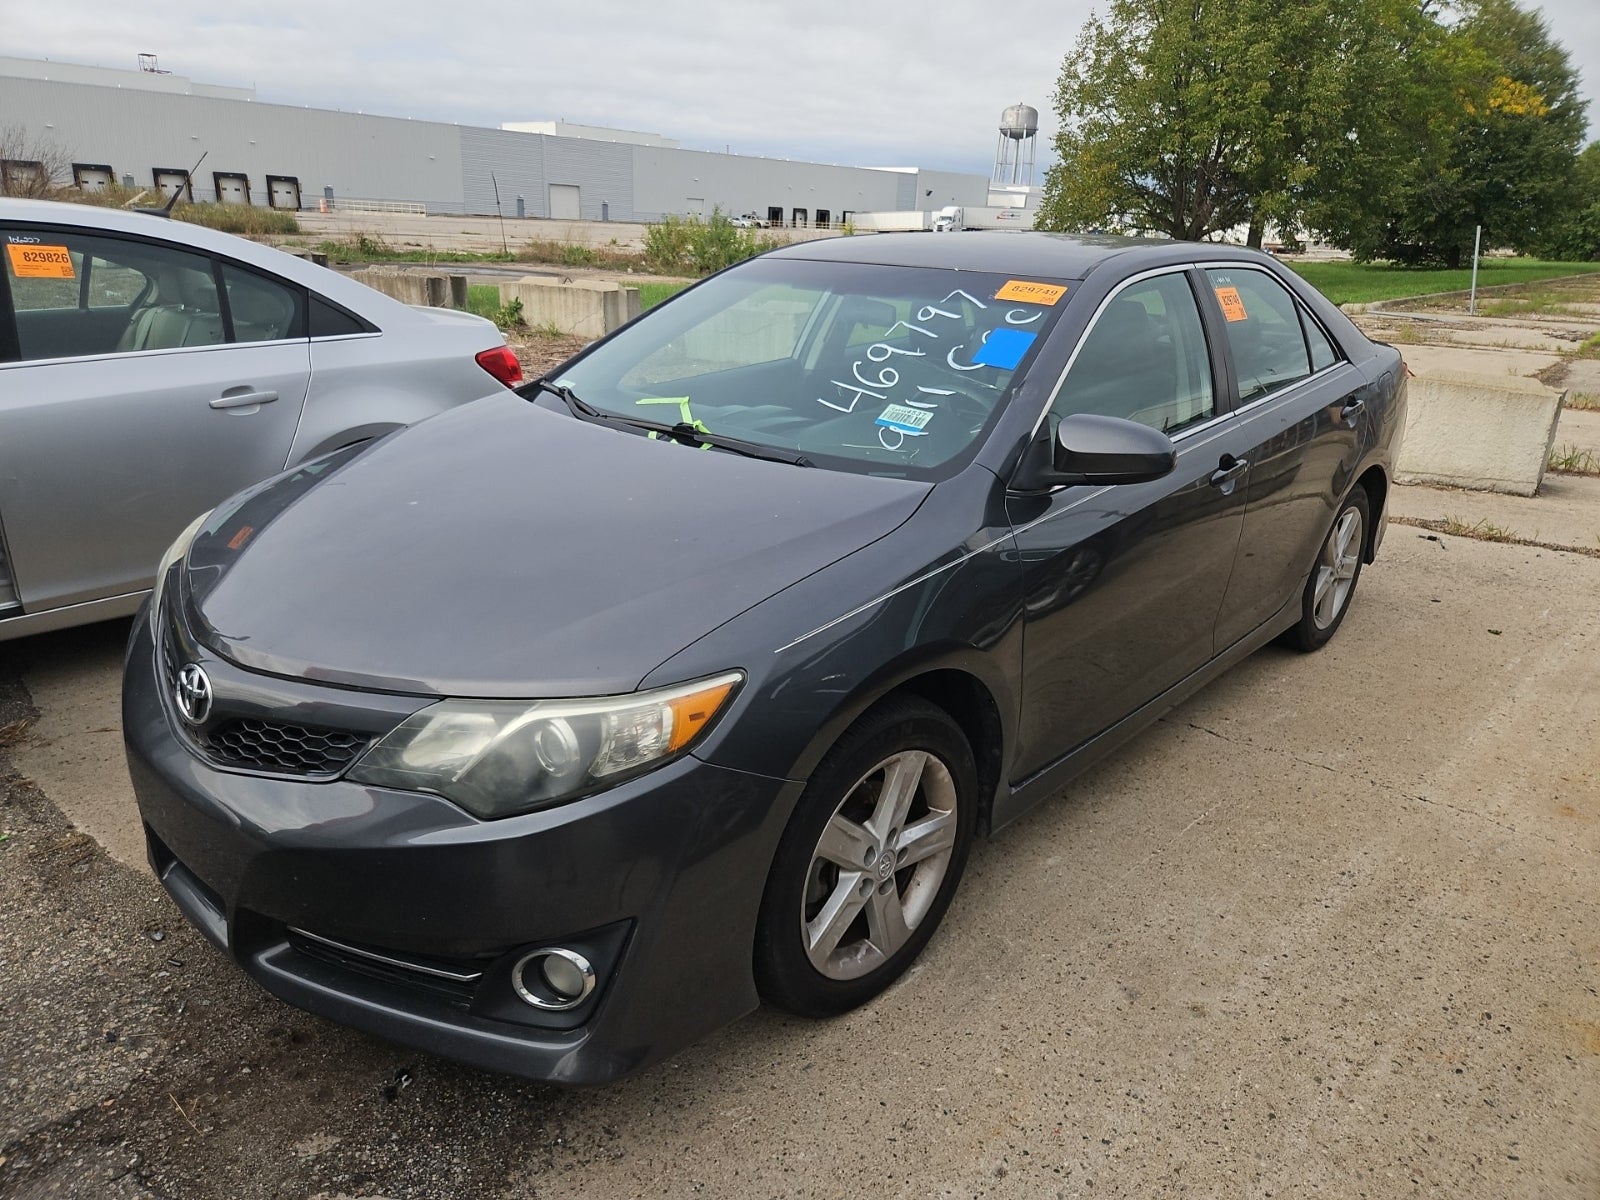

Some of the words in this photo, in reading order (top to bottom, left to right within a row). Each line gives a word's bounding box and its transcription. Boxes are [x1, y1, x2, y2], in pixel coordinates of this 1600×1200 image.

[23, 251, 70, 264] 829826
[1011, 285, 1059, 297] 829749
[816, 289, 988, 413] 469797
